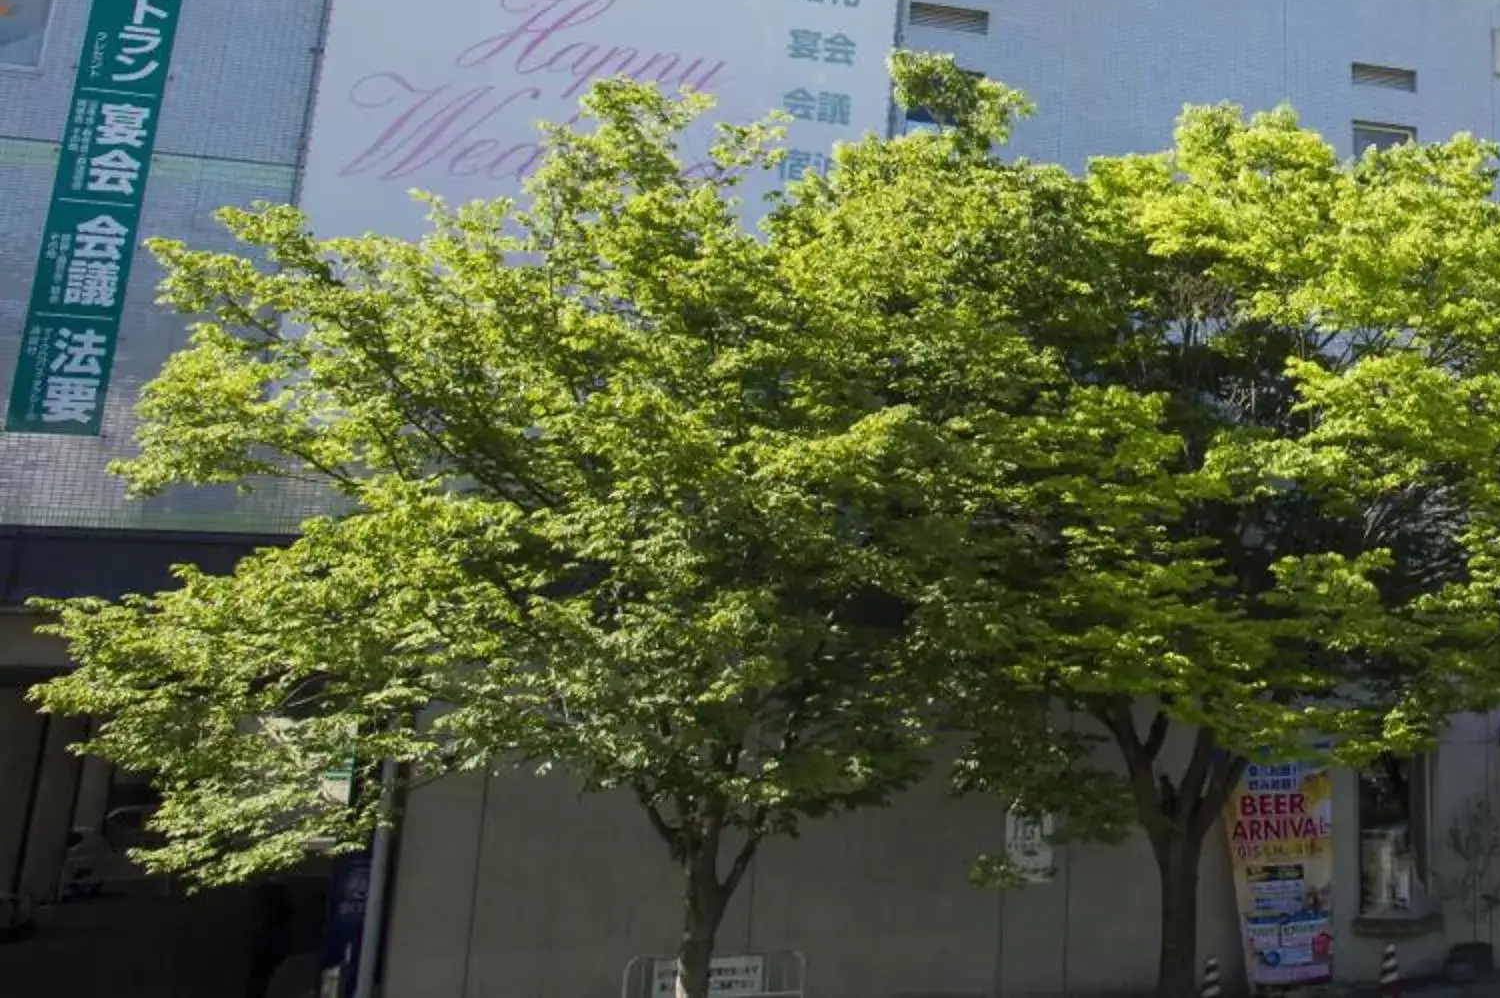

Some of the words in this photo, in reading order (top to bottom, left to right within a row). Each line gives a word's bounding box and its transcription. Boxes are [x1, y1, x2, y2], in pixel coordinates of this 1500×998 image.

[787, 28, 857, 67] 宴会
[783, 87, 852, 127] 会議
[87, 101, 150, 196] 宴会
[62, 214, 129, 307] 会議
[43, 328, 107, 425] 法要
[1240, 793, 1305, 816] BEER
[1232, 815, 1329, 841] ARNIVAL
